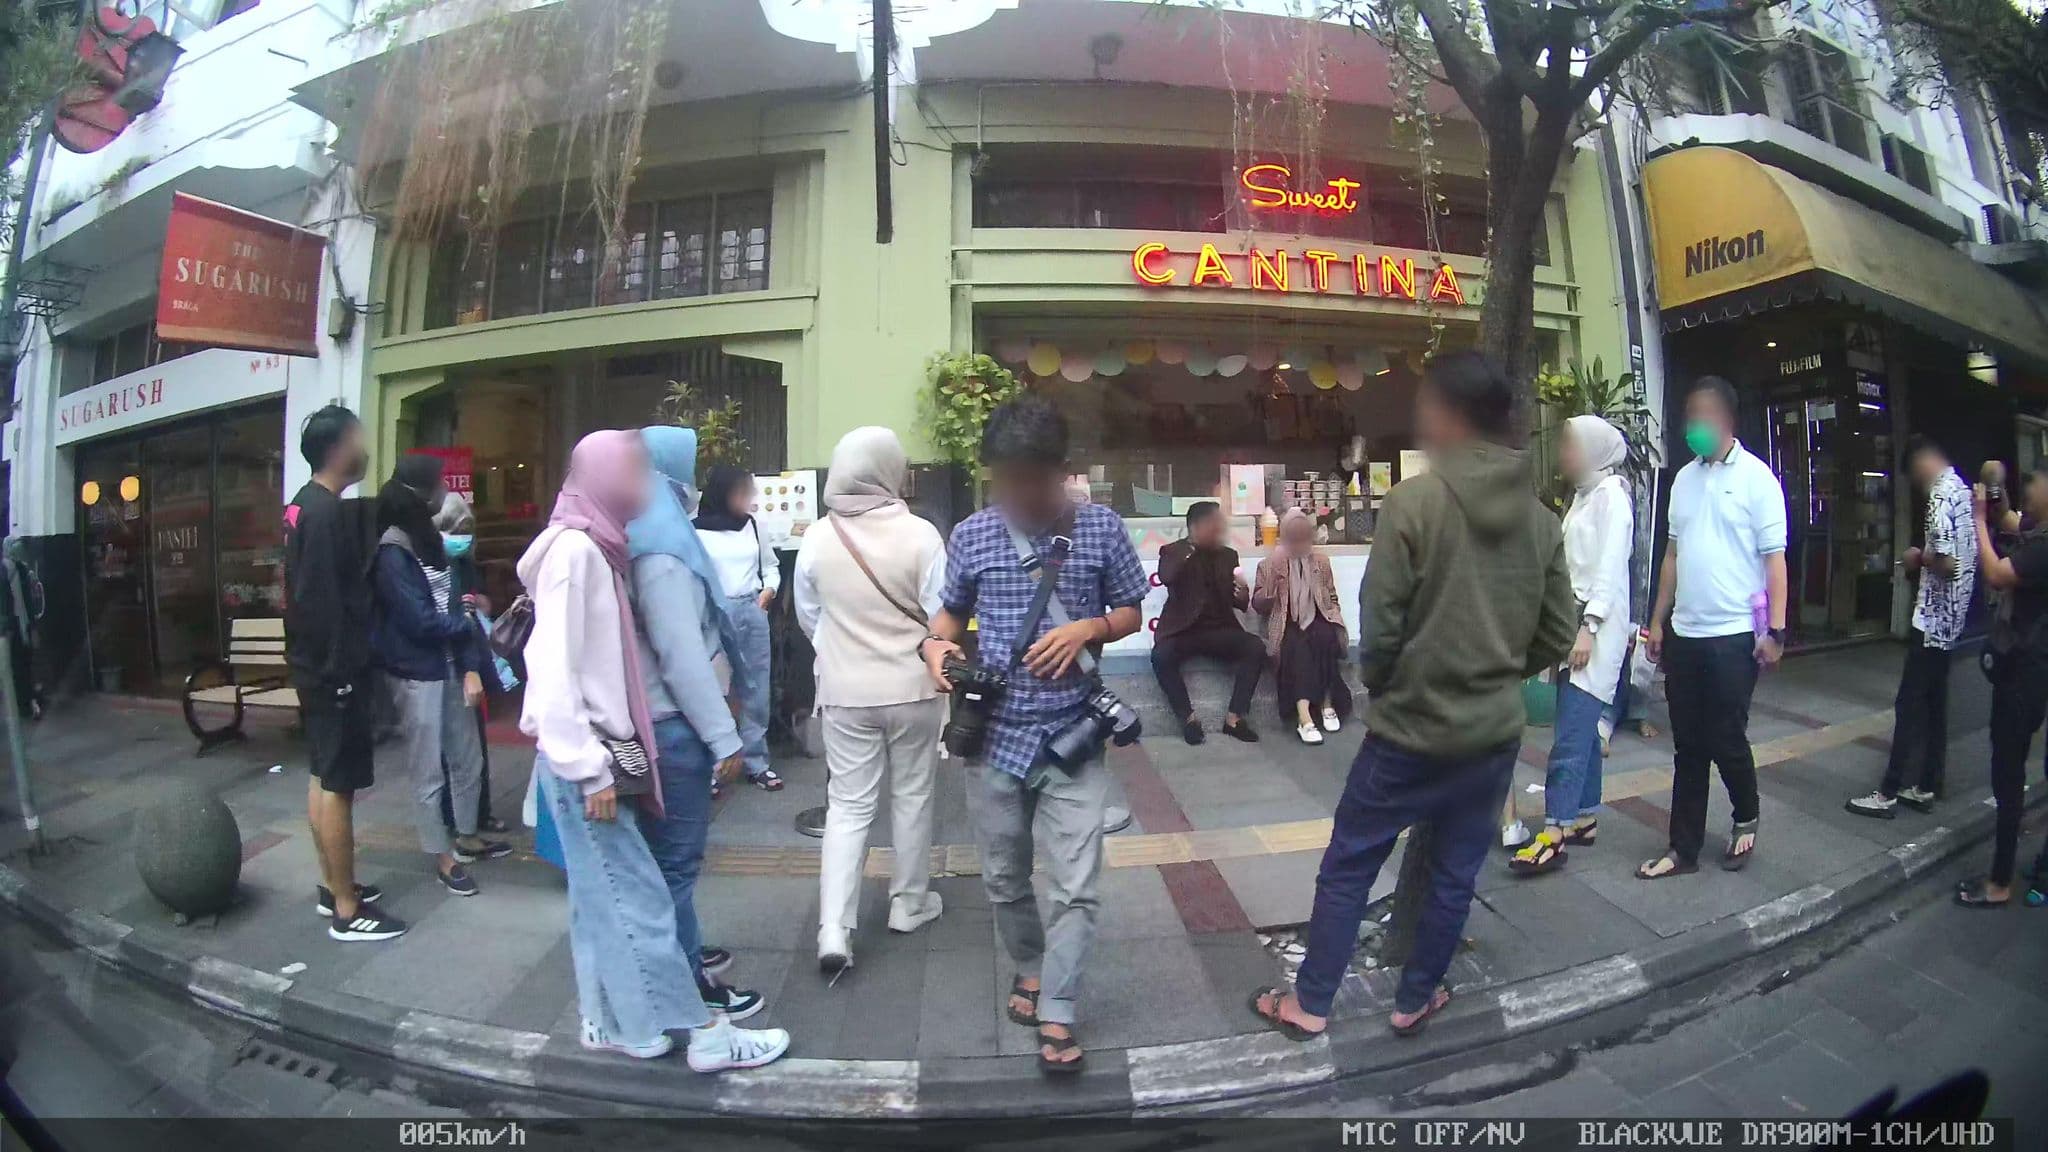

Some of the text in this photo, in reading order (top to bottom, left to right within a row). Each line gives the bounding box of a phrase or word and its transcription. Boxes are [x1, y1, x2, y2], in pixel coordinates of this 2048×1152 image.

[1242, 164, 1361, 211] Sweet
[1132, 242, 1465, 305] CANTINA
[1685, 229, 1764, 278] Nikon
[175, 256, 308, 303] SUGARUSH
[60, 378, 164, 431] SUGARUSH
